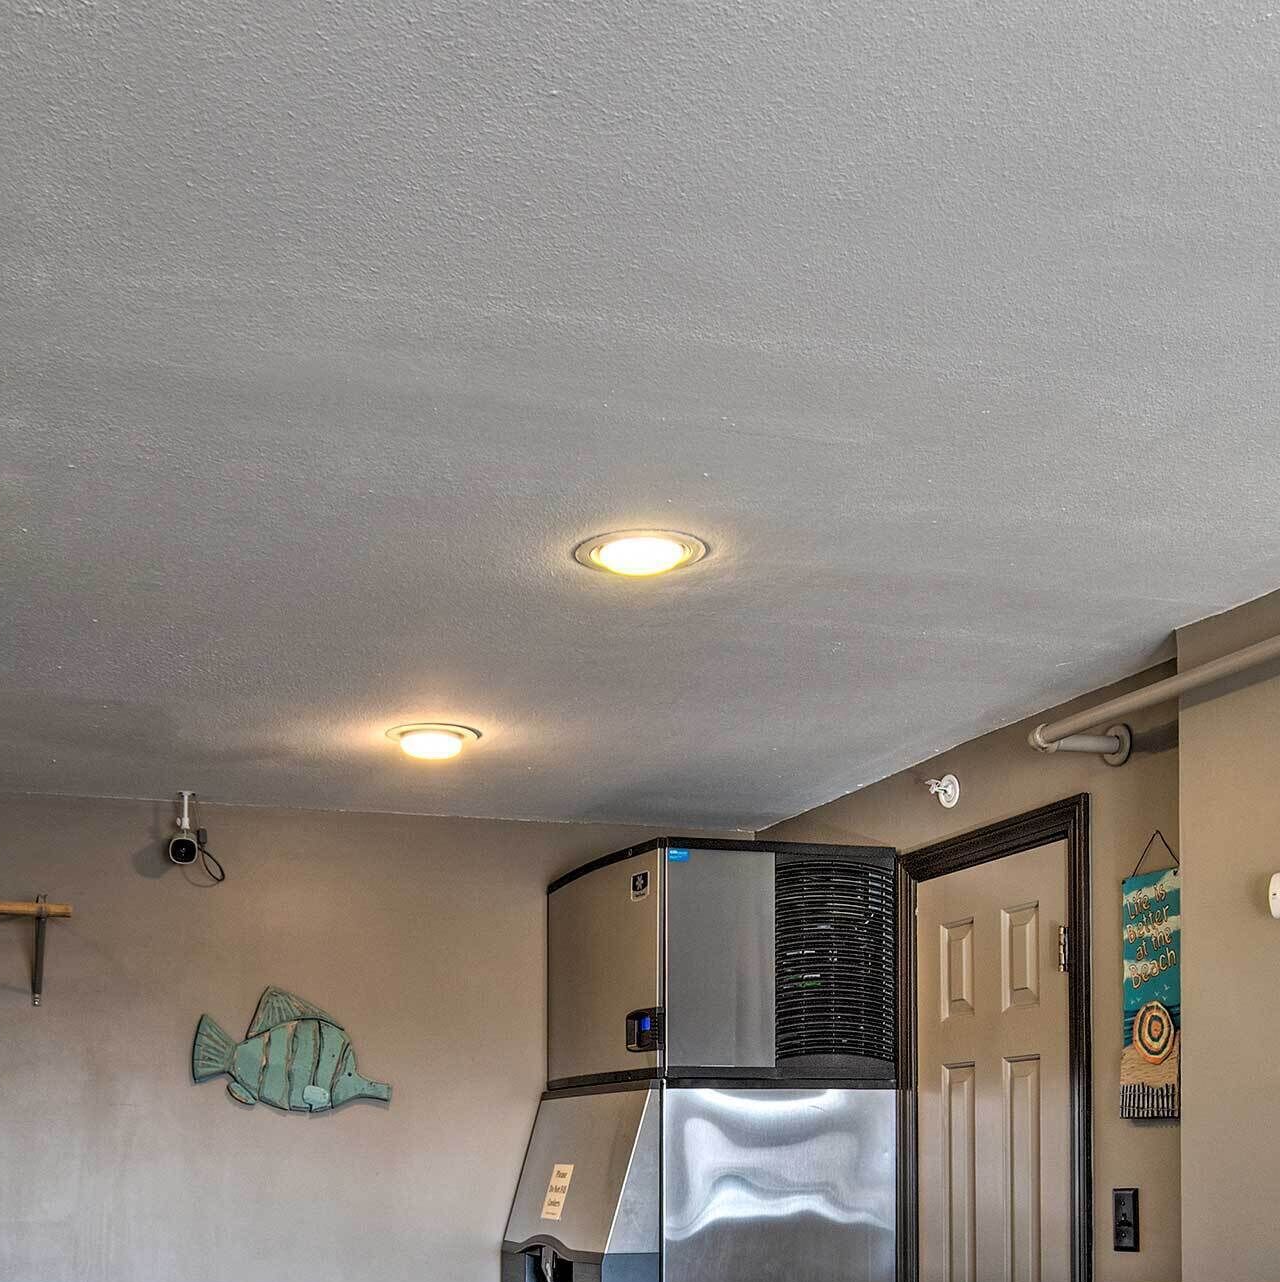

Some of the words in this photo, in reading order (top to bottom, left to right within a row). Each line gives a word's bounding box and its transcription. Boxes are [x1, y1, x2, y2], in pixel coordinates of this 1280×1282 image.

[1126, 888, 1151, 920] Life
[1153, 882, 1167, 902] is
[1126, 905, 1170, 944] Better
[1136, 940, 1148, 961] at
[1151, 927, 1172, 951] the
[1128, 947, 1177, 989] Beach
